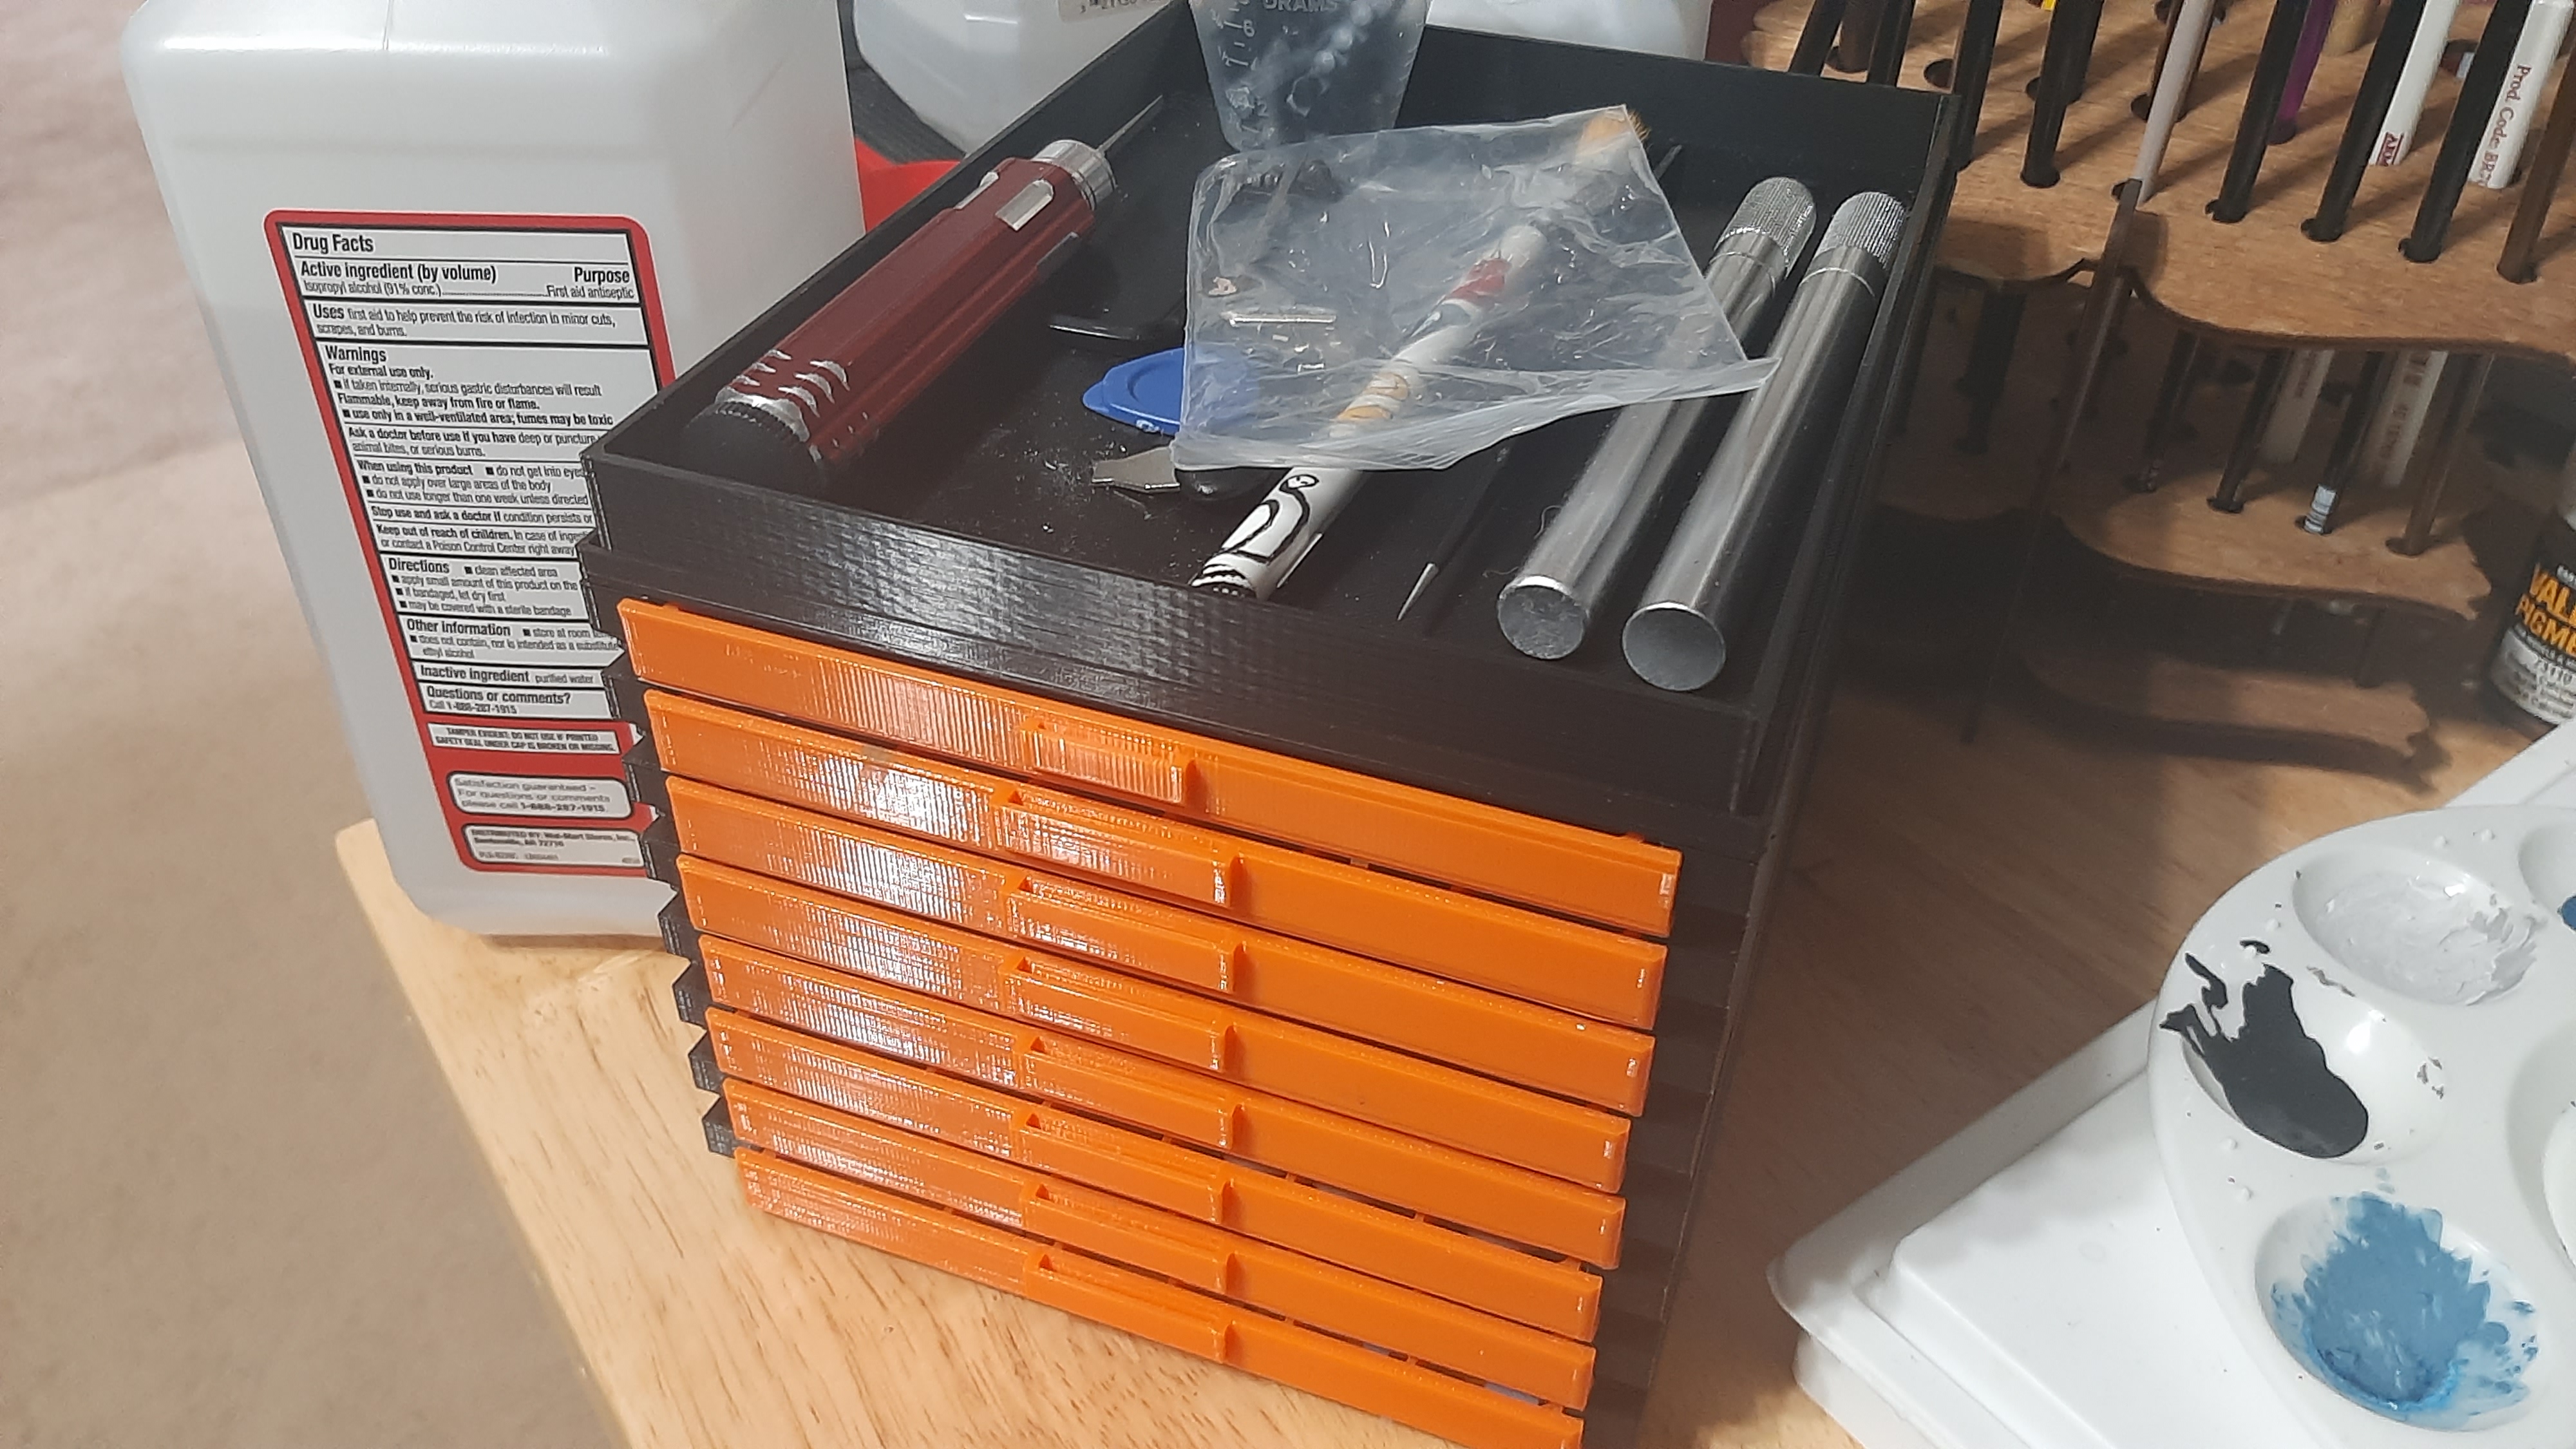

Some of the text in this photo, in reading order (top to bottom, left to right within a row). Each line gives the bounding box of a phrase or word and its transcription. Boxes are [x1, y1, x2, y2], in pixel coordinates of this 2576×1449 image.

[292, 232, 374, 254] Drug Facts
[301, 261, 497, 284] Active ingredient (by volume)
[574, 267, 630, 285] Purpose
[304, 281, 441, 297] Isopropyl alcohol (91% conc.)
[546, 285, 634, 301] First aid antiseptic
[313, 303, 616, 327] Uses first aid to help prevent the risk of infection in minor cuts,
[325, 345, 386, 365] Warnings
[329, 363, 433, 380] For external use only.
[338, 393, 540, 410] Flammable, keep away from fire or flame.
[352, 410, 370, 419] use
[372, 409, 392, 422] only
[394, 410, 404, 421] in
[406, 412, 413, 421] a
[516, 412, 547, 424] fumes
[549, 415, 571, 427] may
[573, 413, 586, 425] be
[588, 413, 613, 426] toxic
[348, 426, 553, 446] Ask a doctor before use if you have deep or
[389, 558, 450, 573] Directions
[407, 618, 511, 636] Other information
[421, 665, 530, 684] Inactive ingredient
[427, 686, 571, 705] Questions or comments?
